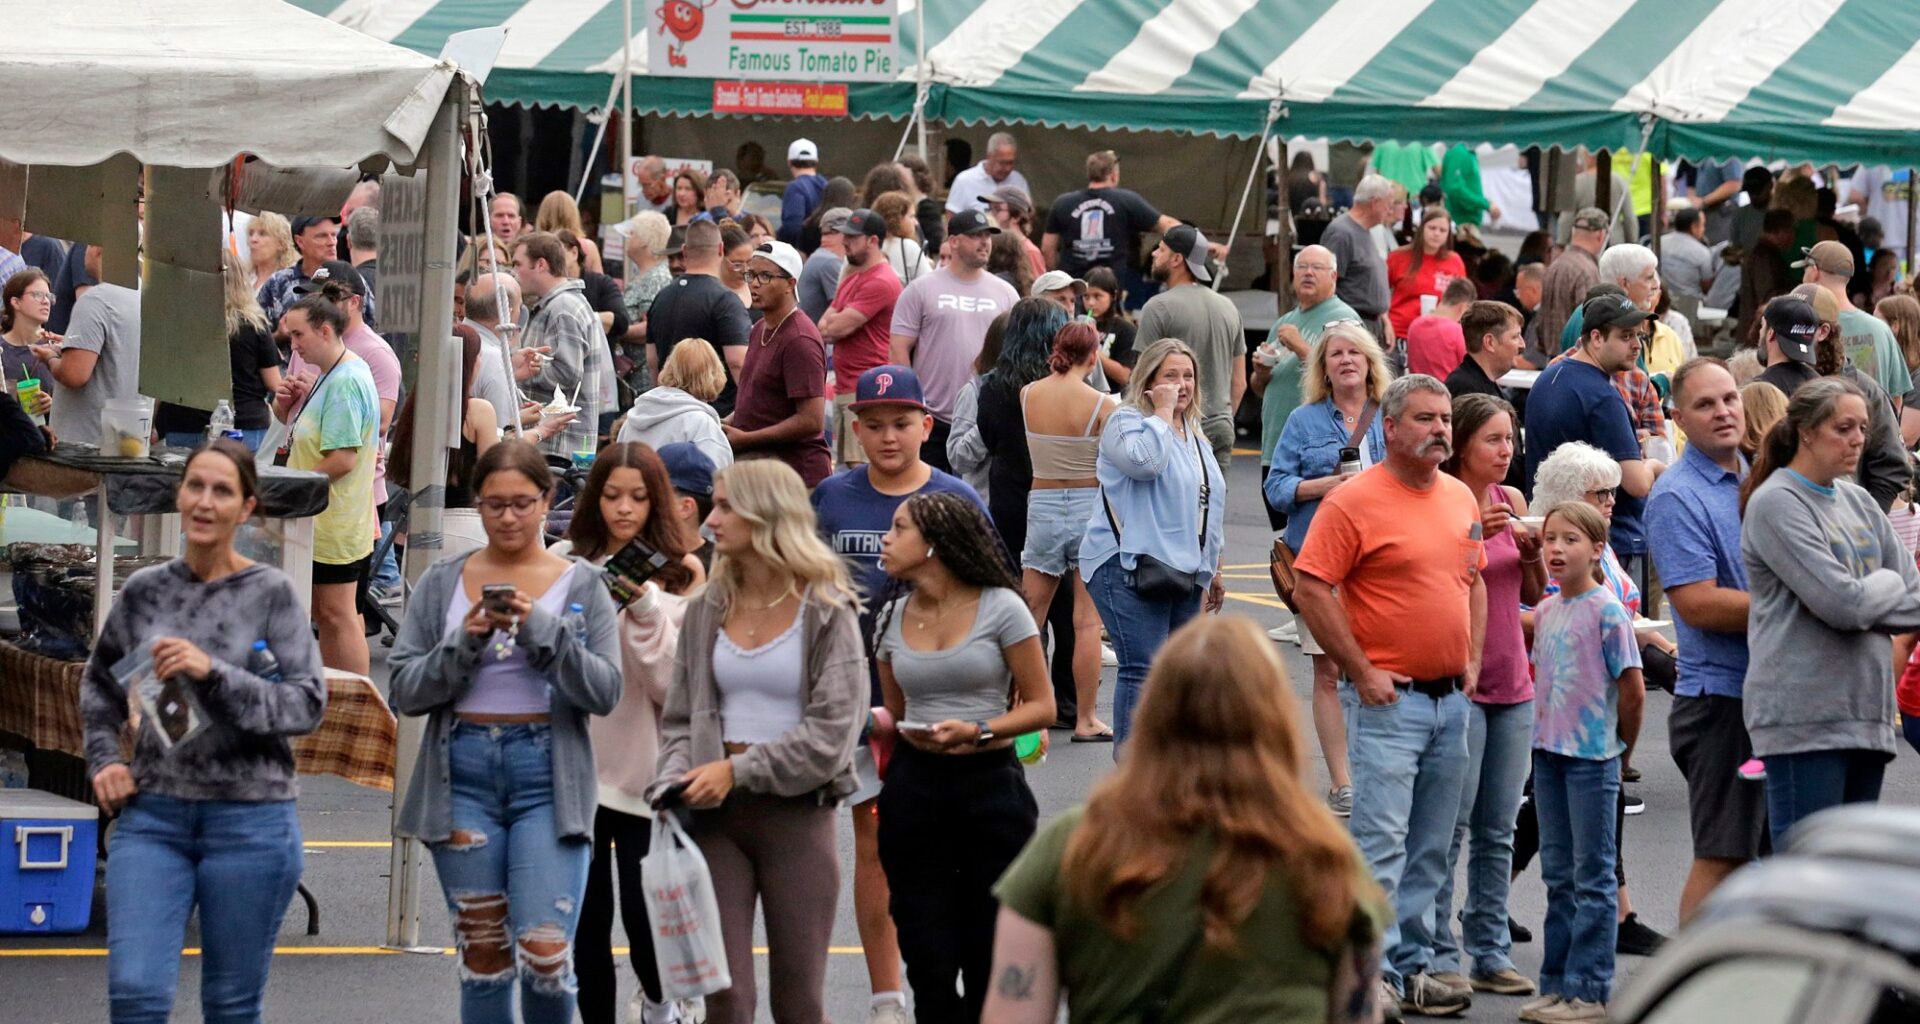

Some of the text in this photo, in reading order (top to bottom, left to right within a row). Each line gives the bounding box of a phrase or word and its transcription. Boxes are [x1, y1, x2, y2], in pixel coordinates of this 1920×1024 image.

[729, 46, 891, 73] Famous Tomato Pie
[938, 294, 997, 312] REP
[875, 373, 893, 396] P
[831, 533, 885, 553] NITTAN
